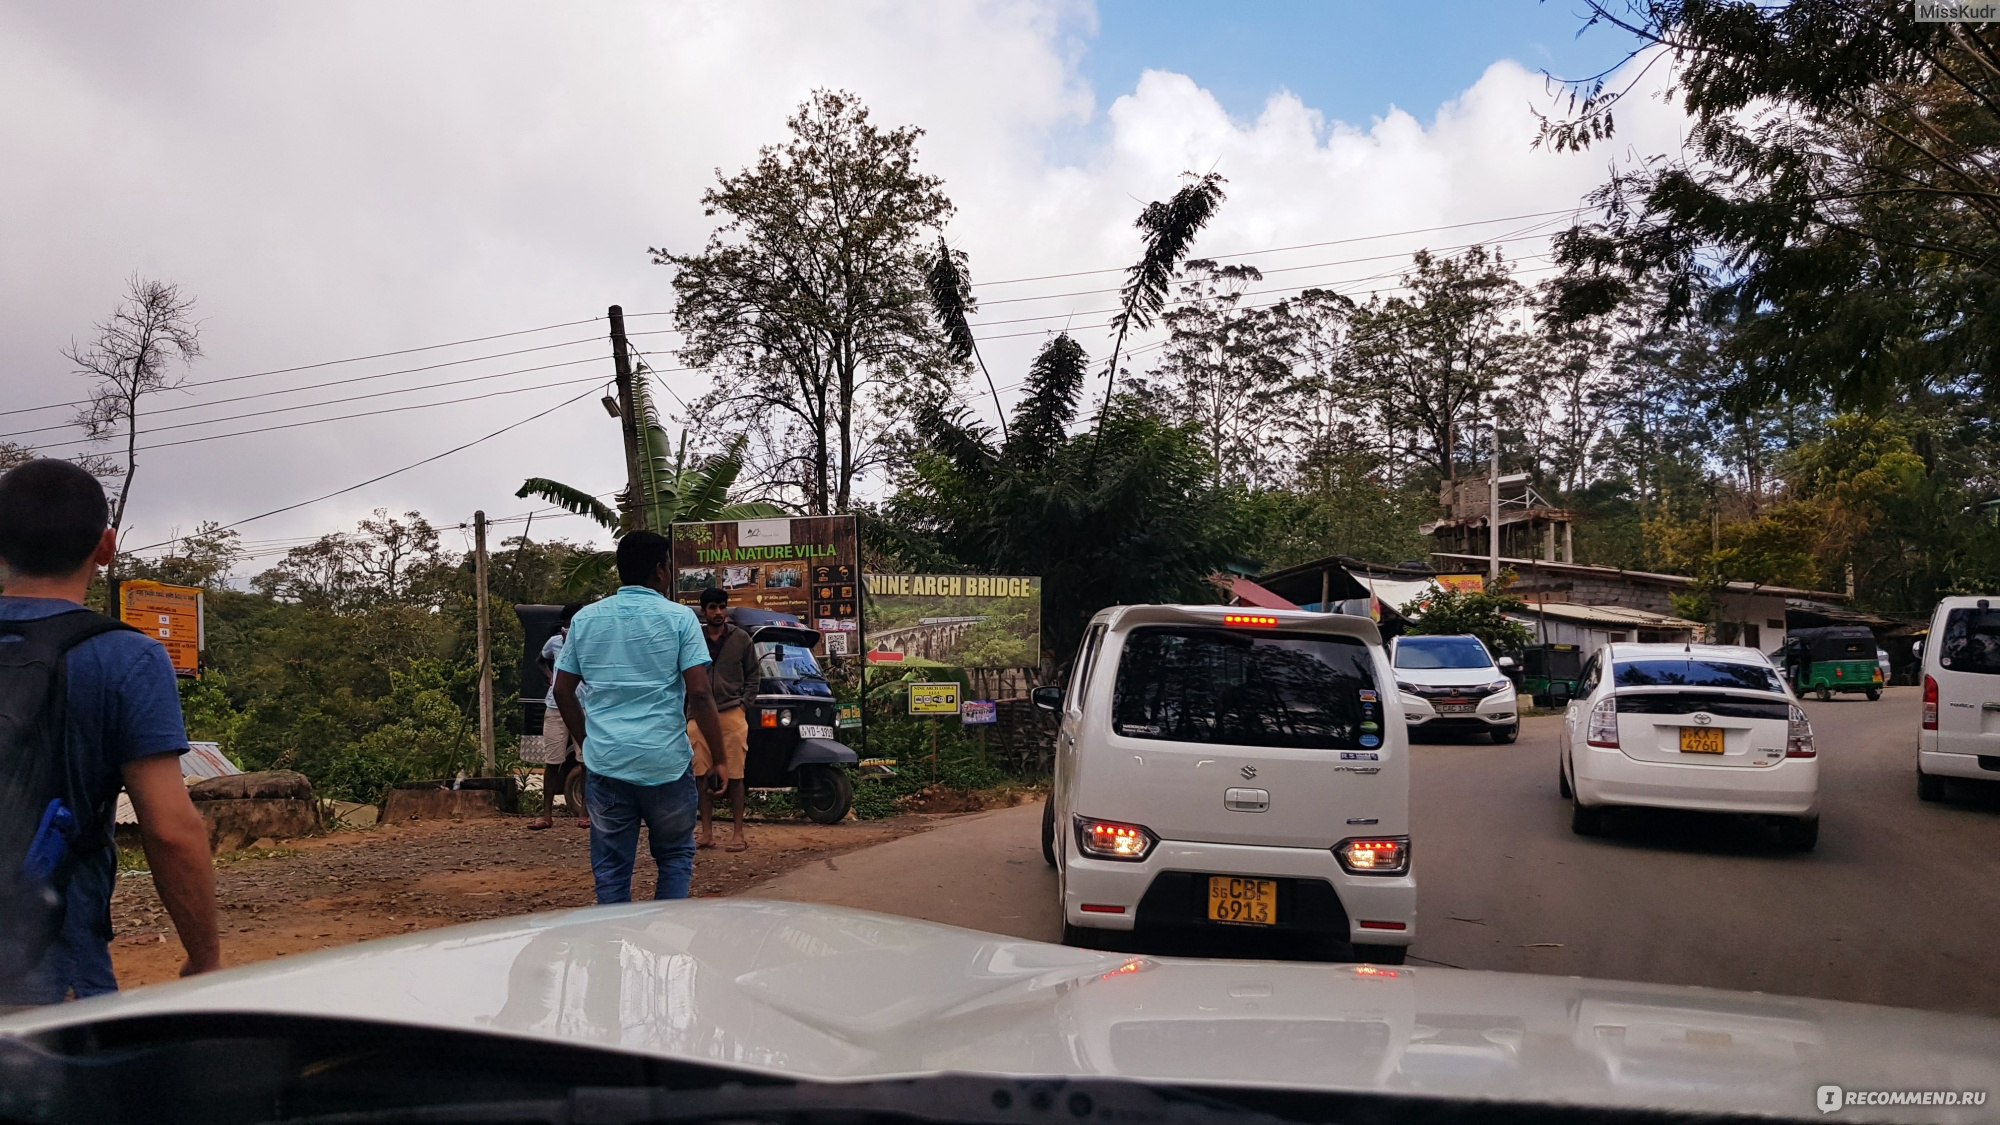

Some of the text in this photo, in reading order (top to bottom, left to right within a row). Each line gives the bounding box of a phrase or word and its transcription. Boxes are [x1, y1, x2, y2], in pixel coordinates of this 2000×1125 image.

[697, 543, 837, 562] TINA NATURE VILLA
[869, 575, 1030, 598] NINE ARCH BRIDGE
[1686, 739, 1719, 752] 4760
[1212, 879, 1270, 900] SG CBF
[1217, 900, 1268, 922] 6913
